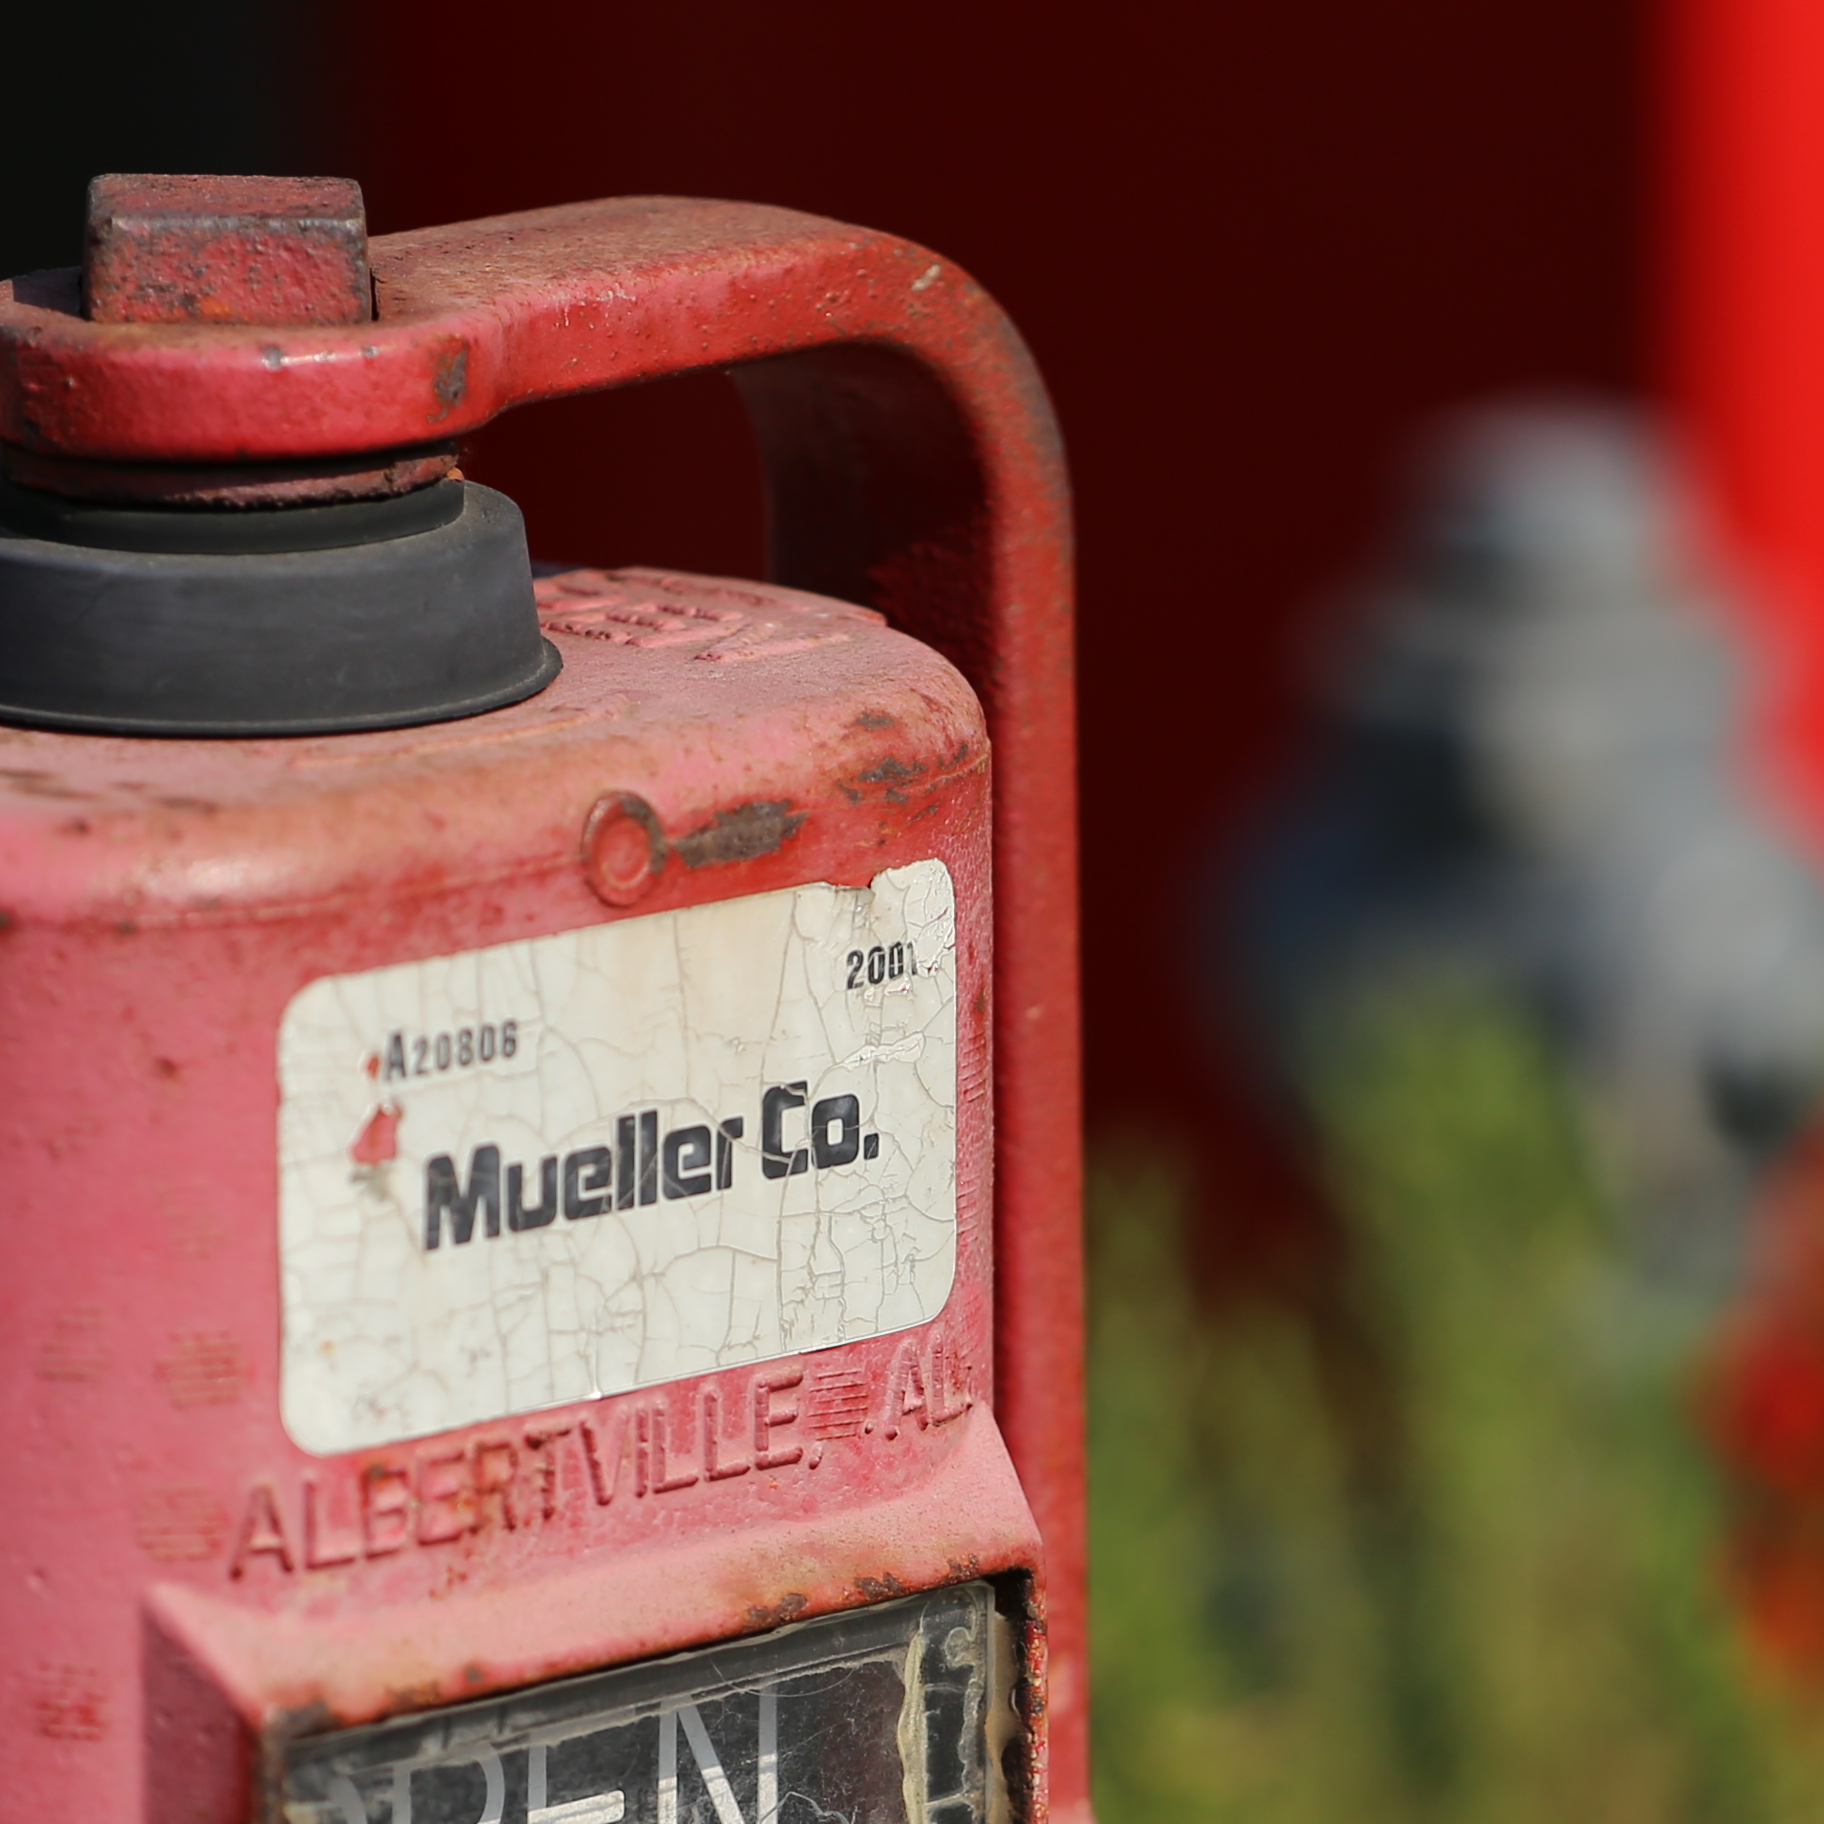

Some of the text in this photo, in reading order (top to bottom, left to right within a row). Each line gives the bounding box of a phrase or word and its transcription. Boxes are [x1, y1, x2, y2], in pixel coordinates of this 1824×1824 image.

[382, 1018, 518, 1082] A20806
[423, 1080, 881, 1252] Mueller Co.
